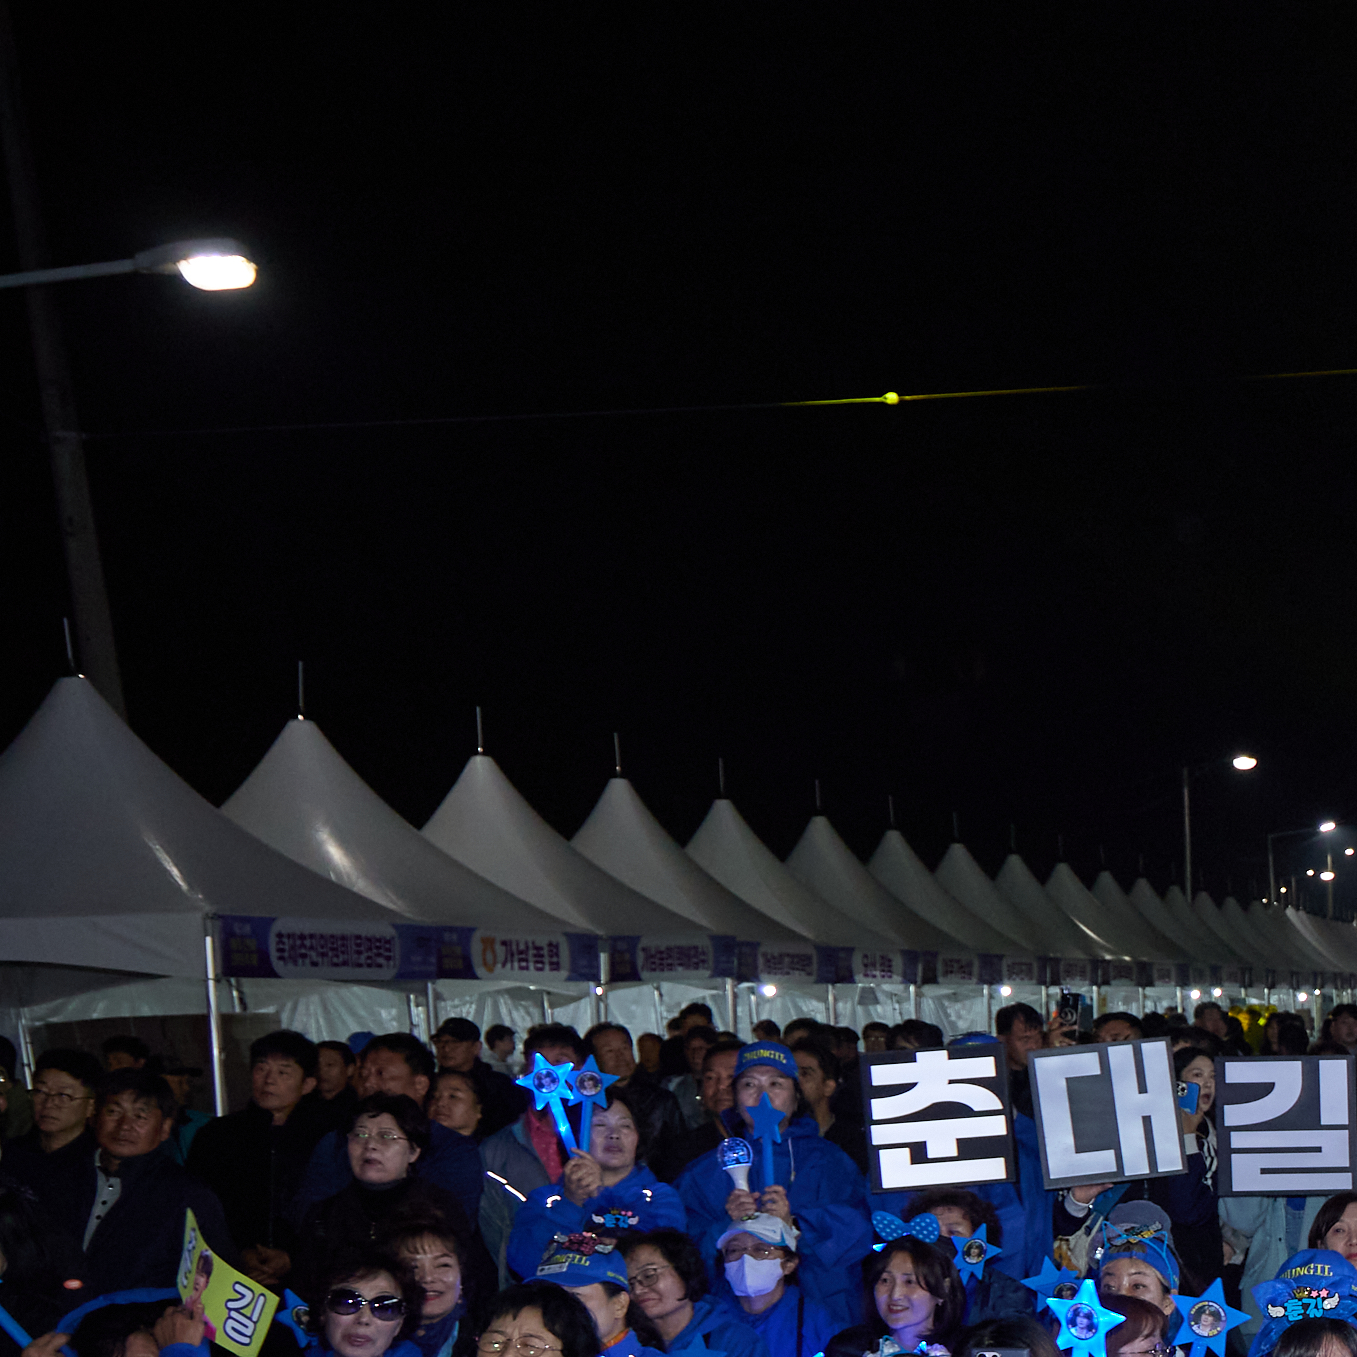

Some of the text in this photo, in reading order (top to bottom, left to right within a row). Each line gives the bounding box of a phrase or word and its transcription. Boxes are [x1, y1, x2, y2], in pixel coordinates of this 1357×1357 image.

[500, 939, 560, 972] 가남농협
[868, 1048, 1009, 1191] 춘
[1032, 1040, 1185, 1181] 대
[1222, 1058, 1353, 1193] 길
[224, 1281, 269, 1346] 길
